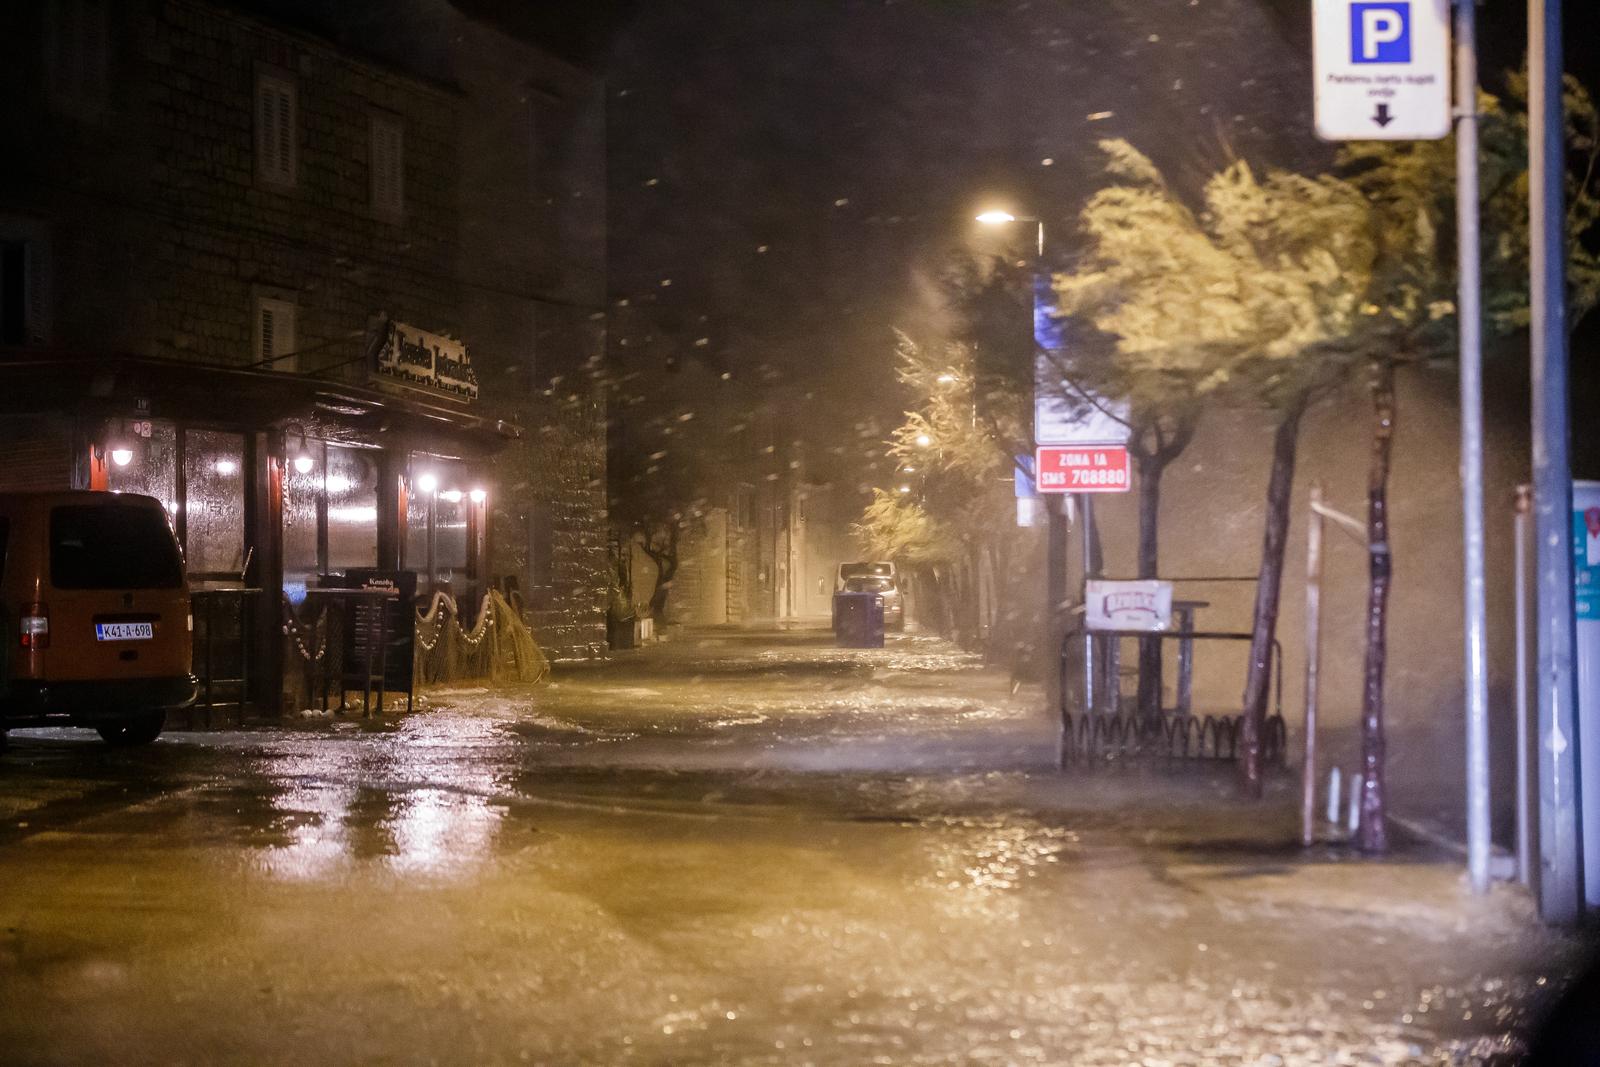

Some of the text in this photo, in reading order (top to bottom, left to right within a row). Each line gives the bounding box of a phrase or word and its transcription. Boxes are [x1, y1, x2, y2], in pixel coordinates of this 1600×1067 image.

[1362, 8, 1403, 59] P
[1059, 453, 1090, 466] ZONA
[1042, 472, 1066, 485] SMS
